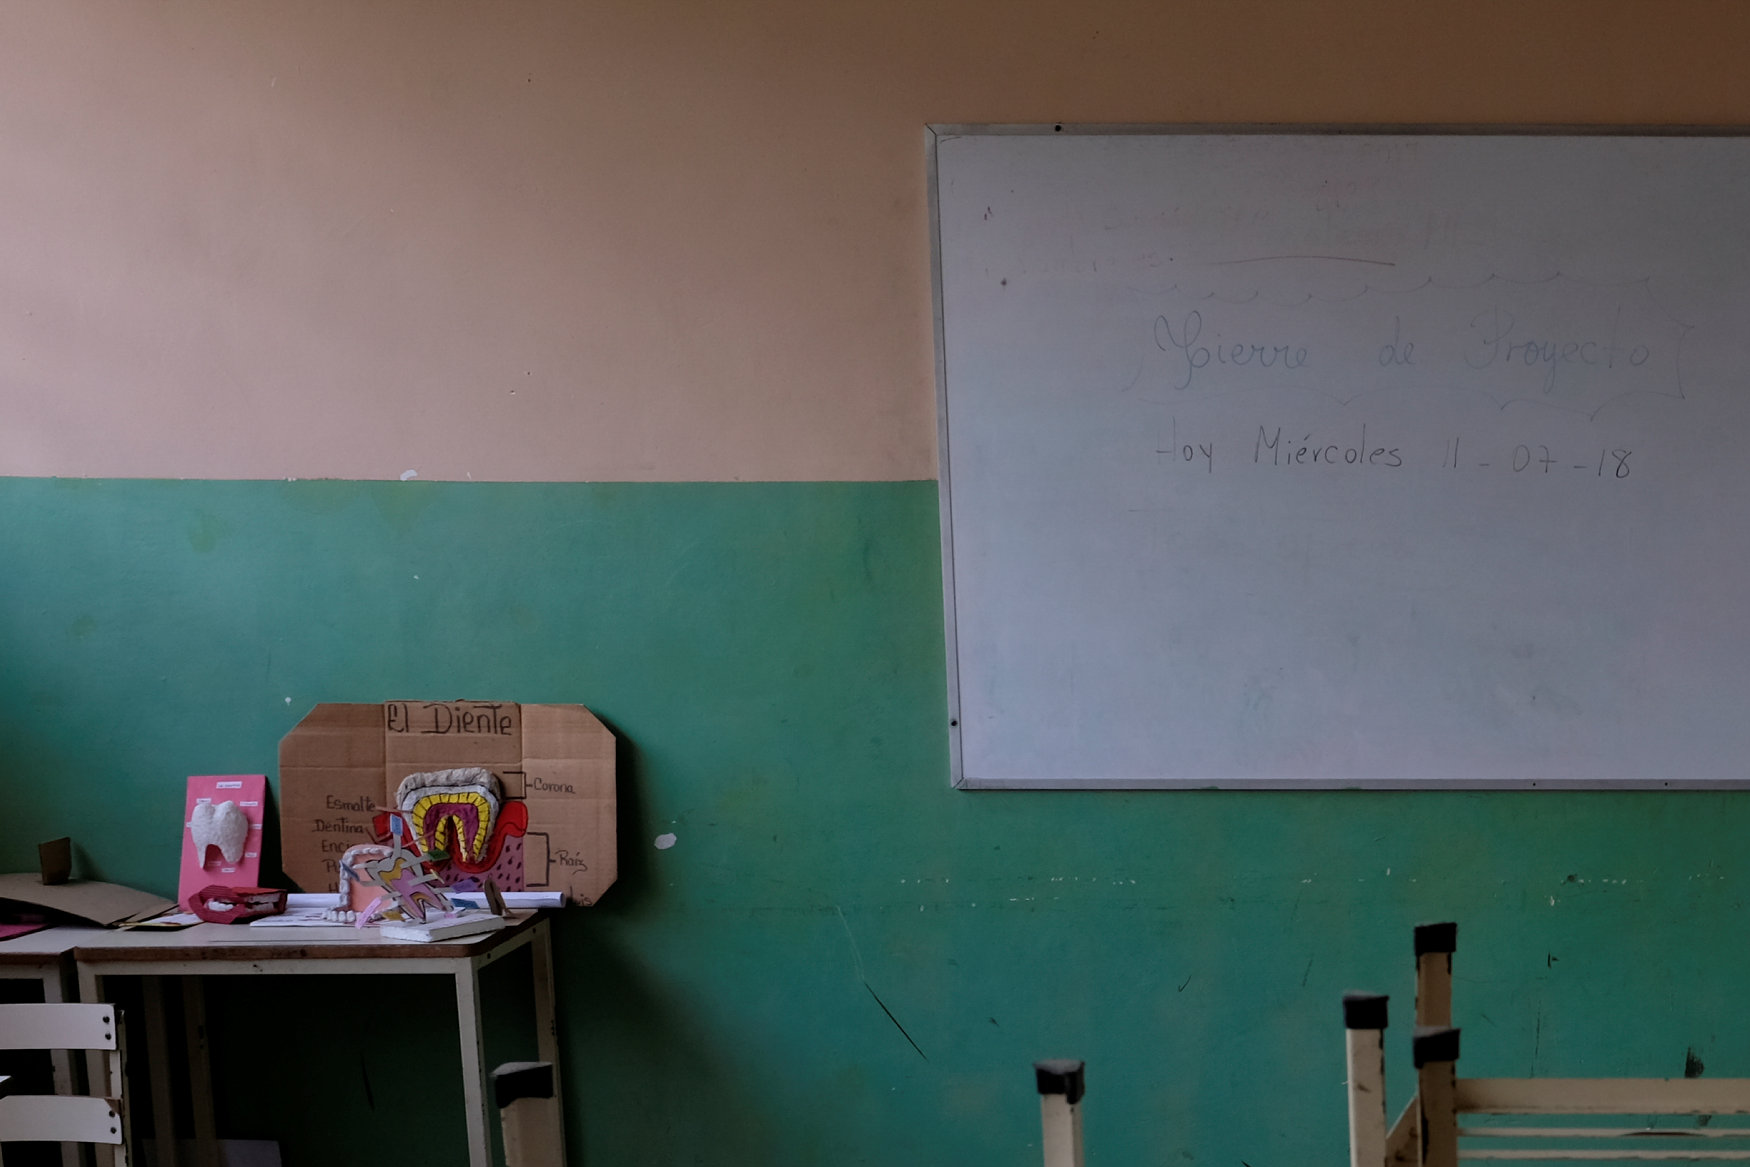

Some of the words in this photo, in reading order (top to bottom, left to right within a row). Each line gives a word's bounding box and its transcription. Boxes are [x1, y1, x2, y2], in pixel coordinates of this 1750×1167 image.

[1376, 314, 1419, 368] de
[1463, 302, 1652, 395] Proyecto
[1253, 421, 1405, 470] Miércoles
[387, 702, 410, 733] El
[420, 702, 513, 736] Diente
[532, 777, 576, 794] Corona
[325, 794, 377, 812] Esmalte
[311, 816, 364, 834] Dentina
